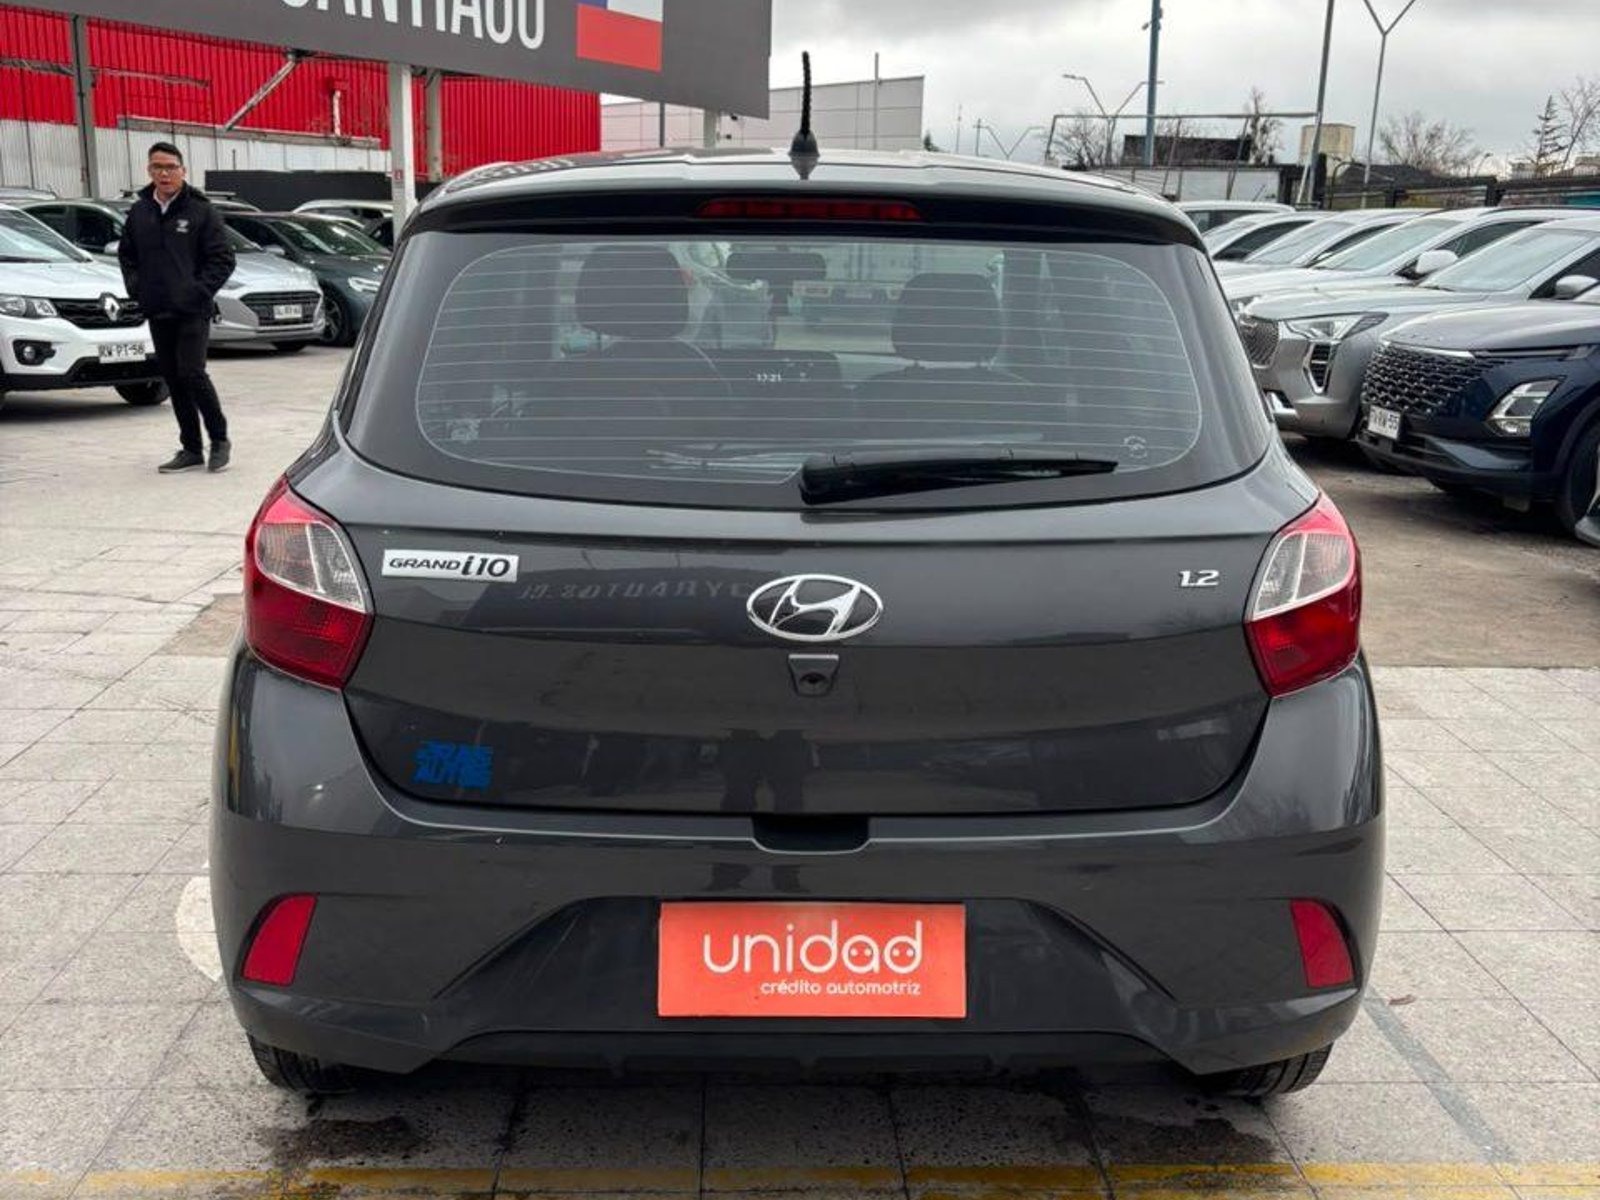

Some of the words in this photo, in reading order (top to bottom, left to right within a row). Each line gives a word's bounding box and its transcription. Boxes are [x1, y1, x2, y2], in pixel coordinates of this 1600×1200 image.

[389, 558, 461, 570] GRAND
[461, 556, 511, 577] i10
[704, 919, 923, 974] unidad
[760, 980, 821, 995] crédito
[826, 980, 921, 995] automotriz
